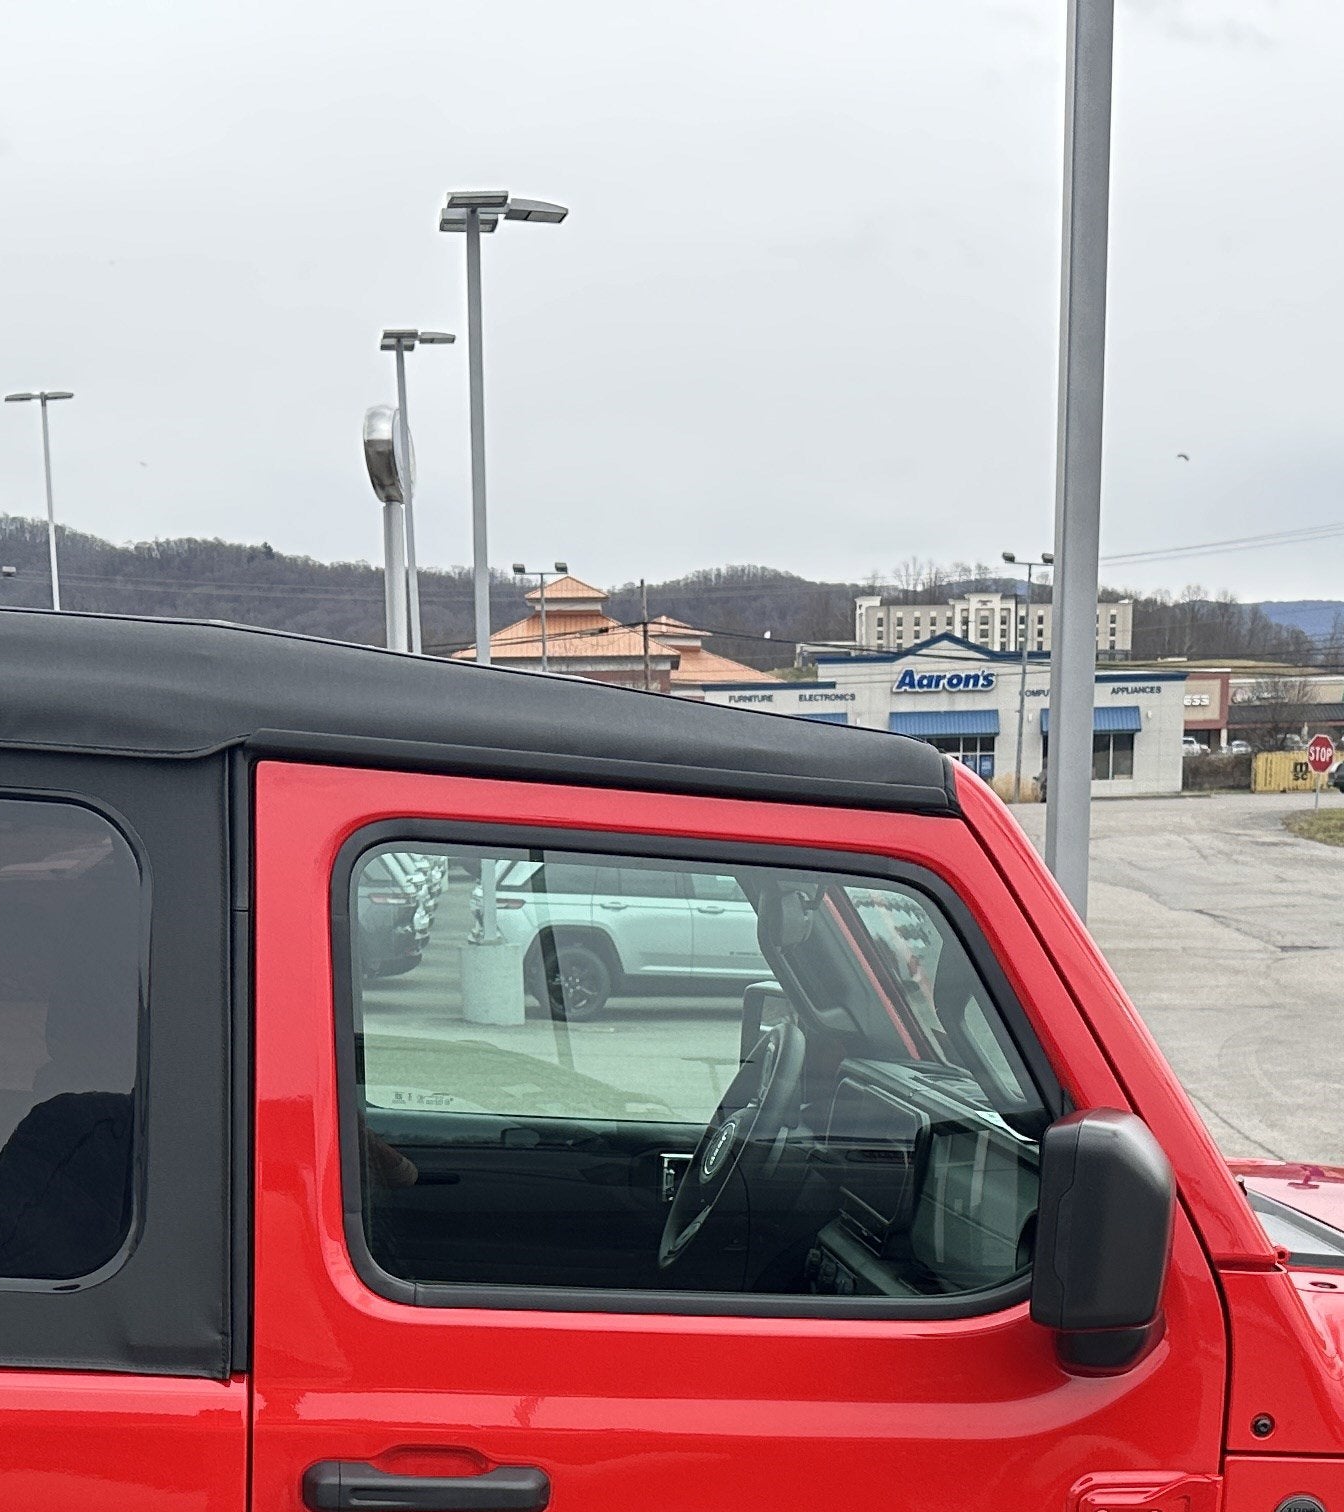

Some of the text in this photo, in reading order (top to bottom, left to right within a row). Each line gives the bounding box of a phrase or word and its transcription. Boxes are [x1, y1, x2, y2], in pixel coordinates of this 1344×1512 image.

[892, 668, 999, 693] Aaron's
[1110, 685, 1162, 695] APPLIANCES
[728, 693, 774, 703] FURNITURE
[798, 692, 856, 702] ELECTRONICS
[1309, 747, 1333, 762] STOP
